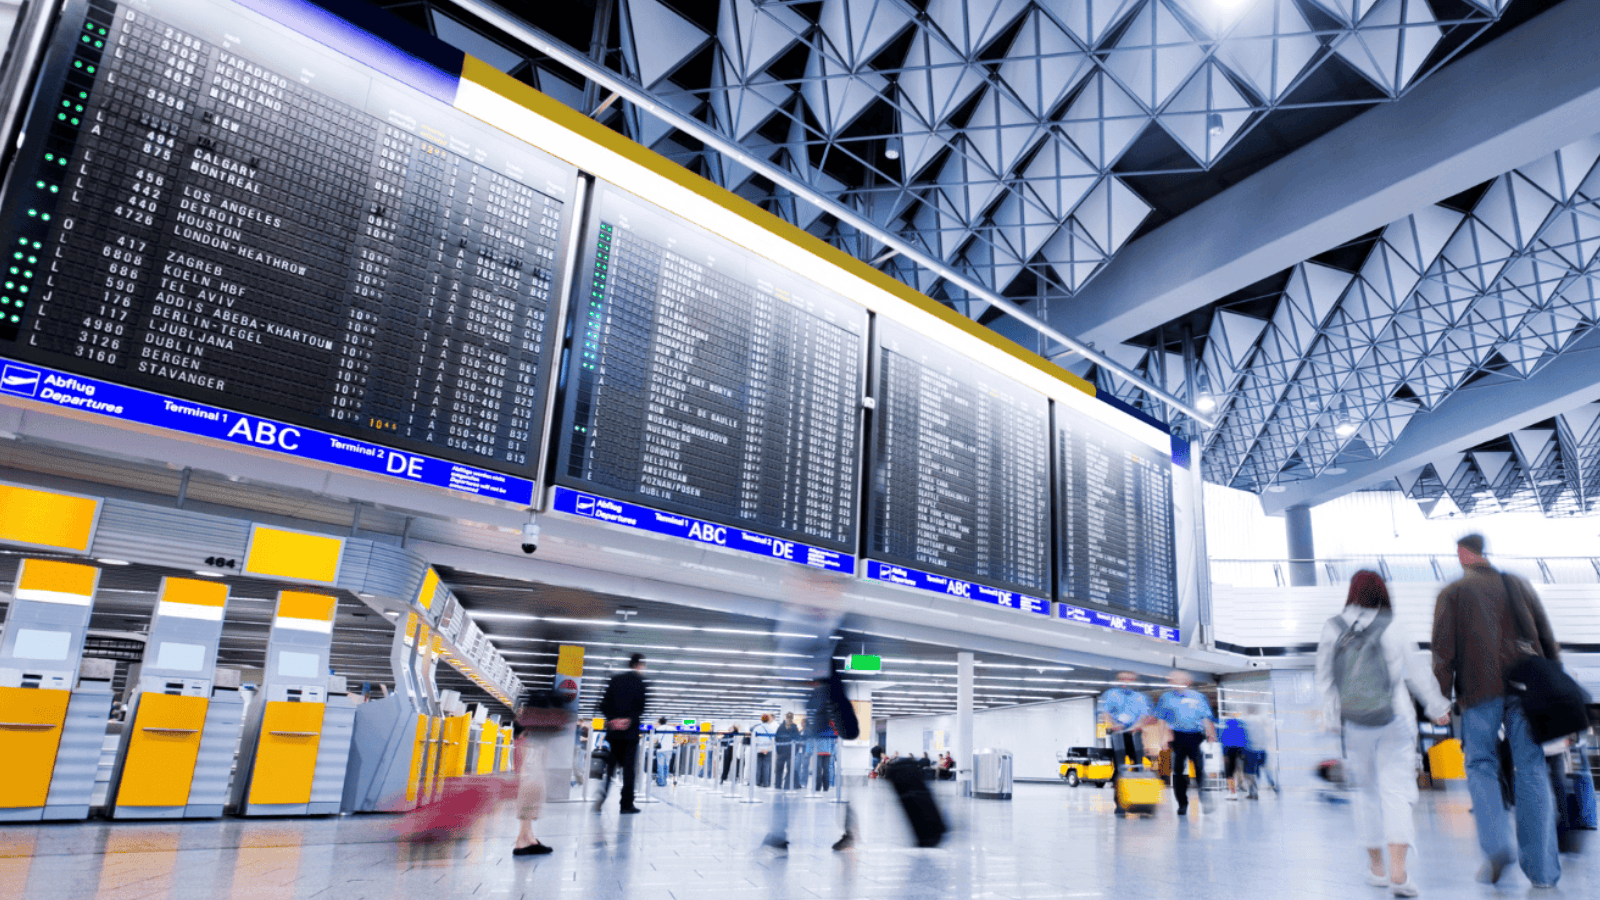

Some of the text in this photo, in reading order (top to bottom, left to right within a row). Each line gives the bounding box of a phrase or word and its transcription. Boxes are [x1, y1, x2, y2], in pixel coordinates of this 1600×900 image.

[117, 34, 128, 46] L
[166, 55, 195, 74] 468
[212, 75, 281, 111] PORTLAND
[121, 22, 131, 33] L
[160, 39, 198, 62] 3102
[215, 63, 284, 100] HELSINKI
[125, 9, 135, 21] D
[164, 27, 201, 51] 2188
[218, 51, 287, 89] VARADERO
[106, 71, 239, 133] L 3236 IEW
[114, 46, 253, 112] L 462 MIAMI
[91, 123, 101, 135] A
[142, 142, 171, 161] 875
[190, 160, 262, 194] MONTREAL
[95, 110, 105, 122] L
[145, 129, 175, 148] 494
[193, 147, 256, 179] CALGARY
[75, 176, 86, 188] L
[127, 194, 158, 212] 440
[176, 211, 241, 241] HOUSTON
[79, 163, 90, 175] L
[131, 181, 161, 199] 442
[180, 198, 244, 228] DETROIT
[83, 149, 94, 161] L
[135, 168, 165, 186] 456
[183, 185, 212, 203] LOS
[220, 198, 282, 228] ANGELES
[62, 217, 74, 229] O
[116, 234, 147, 252] 417
[166, 250, 223, 276] ZAGREB
[71, 190, 82, 202] L
[113, 204, 154, 226] 4726
[173, 224, 307, 276] LONDON-HEATHROW
[54, 245, 65, 258] L
[108, 262, 140, 280] 686
[159, 277, 189, 294] TEL
[198, 288, 235, 308] AVIV
[58, 231, 70, 243] L
[102, 245, 143, 266] 6808
[162, 263, 211, 287] KOELN
[219, 281, 247, 298] HBF
[36, 303, 48, 316] L
[82, 315, 125, 336] 4980
[144, 332, 204, 356] DUBLIN
[41, 289, 53, 301] J
[96, 304, 128, 321] 117
[148, 318, 235, 350] LJUBLJANA
[45, 274, 57, 286] L
[100, 290, 132, 307] 176
[152, 304, 265, 344] BERLIN-TEGEL
[50, 260, 61, 272] L
[104, 276, 136, 293] 590
[155, 290, 204, 313] ADDIS
[213, 307, 334, 350] ABEBA-KHARTOUM
[28, 333, 40, 345] L
[73, 344, 117, 364] 3160
[137, 360, 226, 391] STAVANGER
[32, 318, 44, 331] L
[77, 330, 121, 350] 3126
[141, 346, 201, 370] BERGEN
[654, 355, 688, 373] KOLKATA
[40, 388, 124, 414] Departures
[44, 374, 96, 396] Abflug
[651, 384, 685, 402] DETROIT
[652, 374, 686, 392] CHICAGO
[164, 400, 425, 478] Terminal 1 ABC Terminal 2 DE
[650, 394, 738, 429] PARIS CH. DE GAULLE
[643, 454, 683, 471] HELSINKI
[644, 444, 679, 460] TORONTO
[645, 434, 680, 450] VILNIUS
[640, 484, 670, 499] DUBLIN
[641, 474, 700, 496] POZNAN/POSEN
[642, 464, 687, 483] AMSTERDAM
[595, 510, 637, 526] Departures
[596, 500, 622, 514] Abflug
[654, 512, 684, 526] Terminal
[688, 522, 726, 544] ABC
[740, 532, 767, 544] Terminal
[772, 540, 794, 559] DE
[946, 580, 970, 598] ABC
[998, 591, 1012, 606] DE
[1110, 616, 1126, 630] ABC
[1144, 624, 1154, 636] DE
